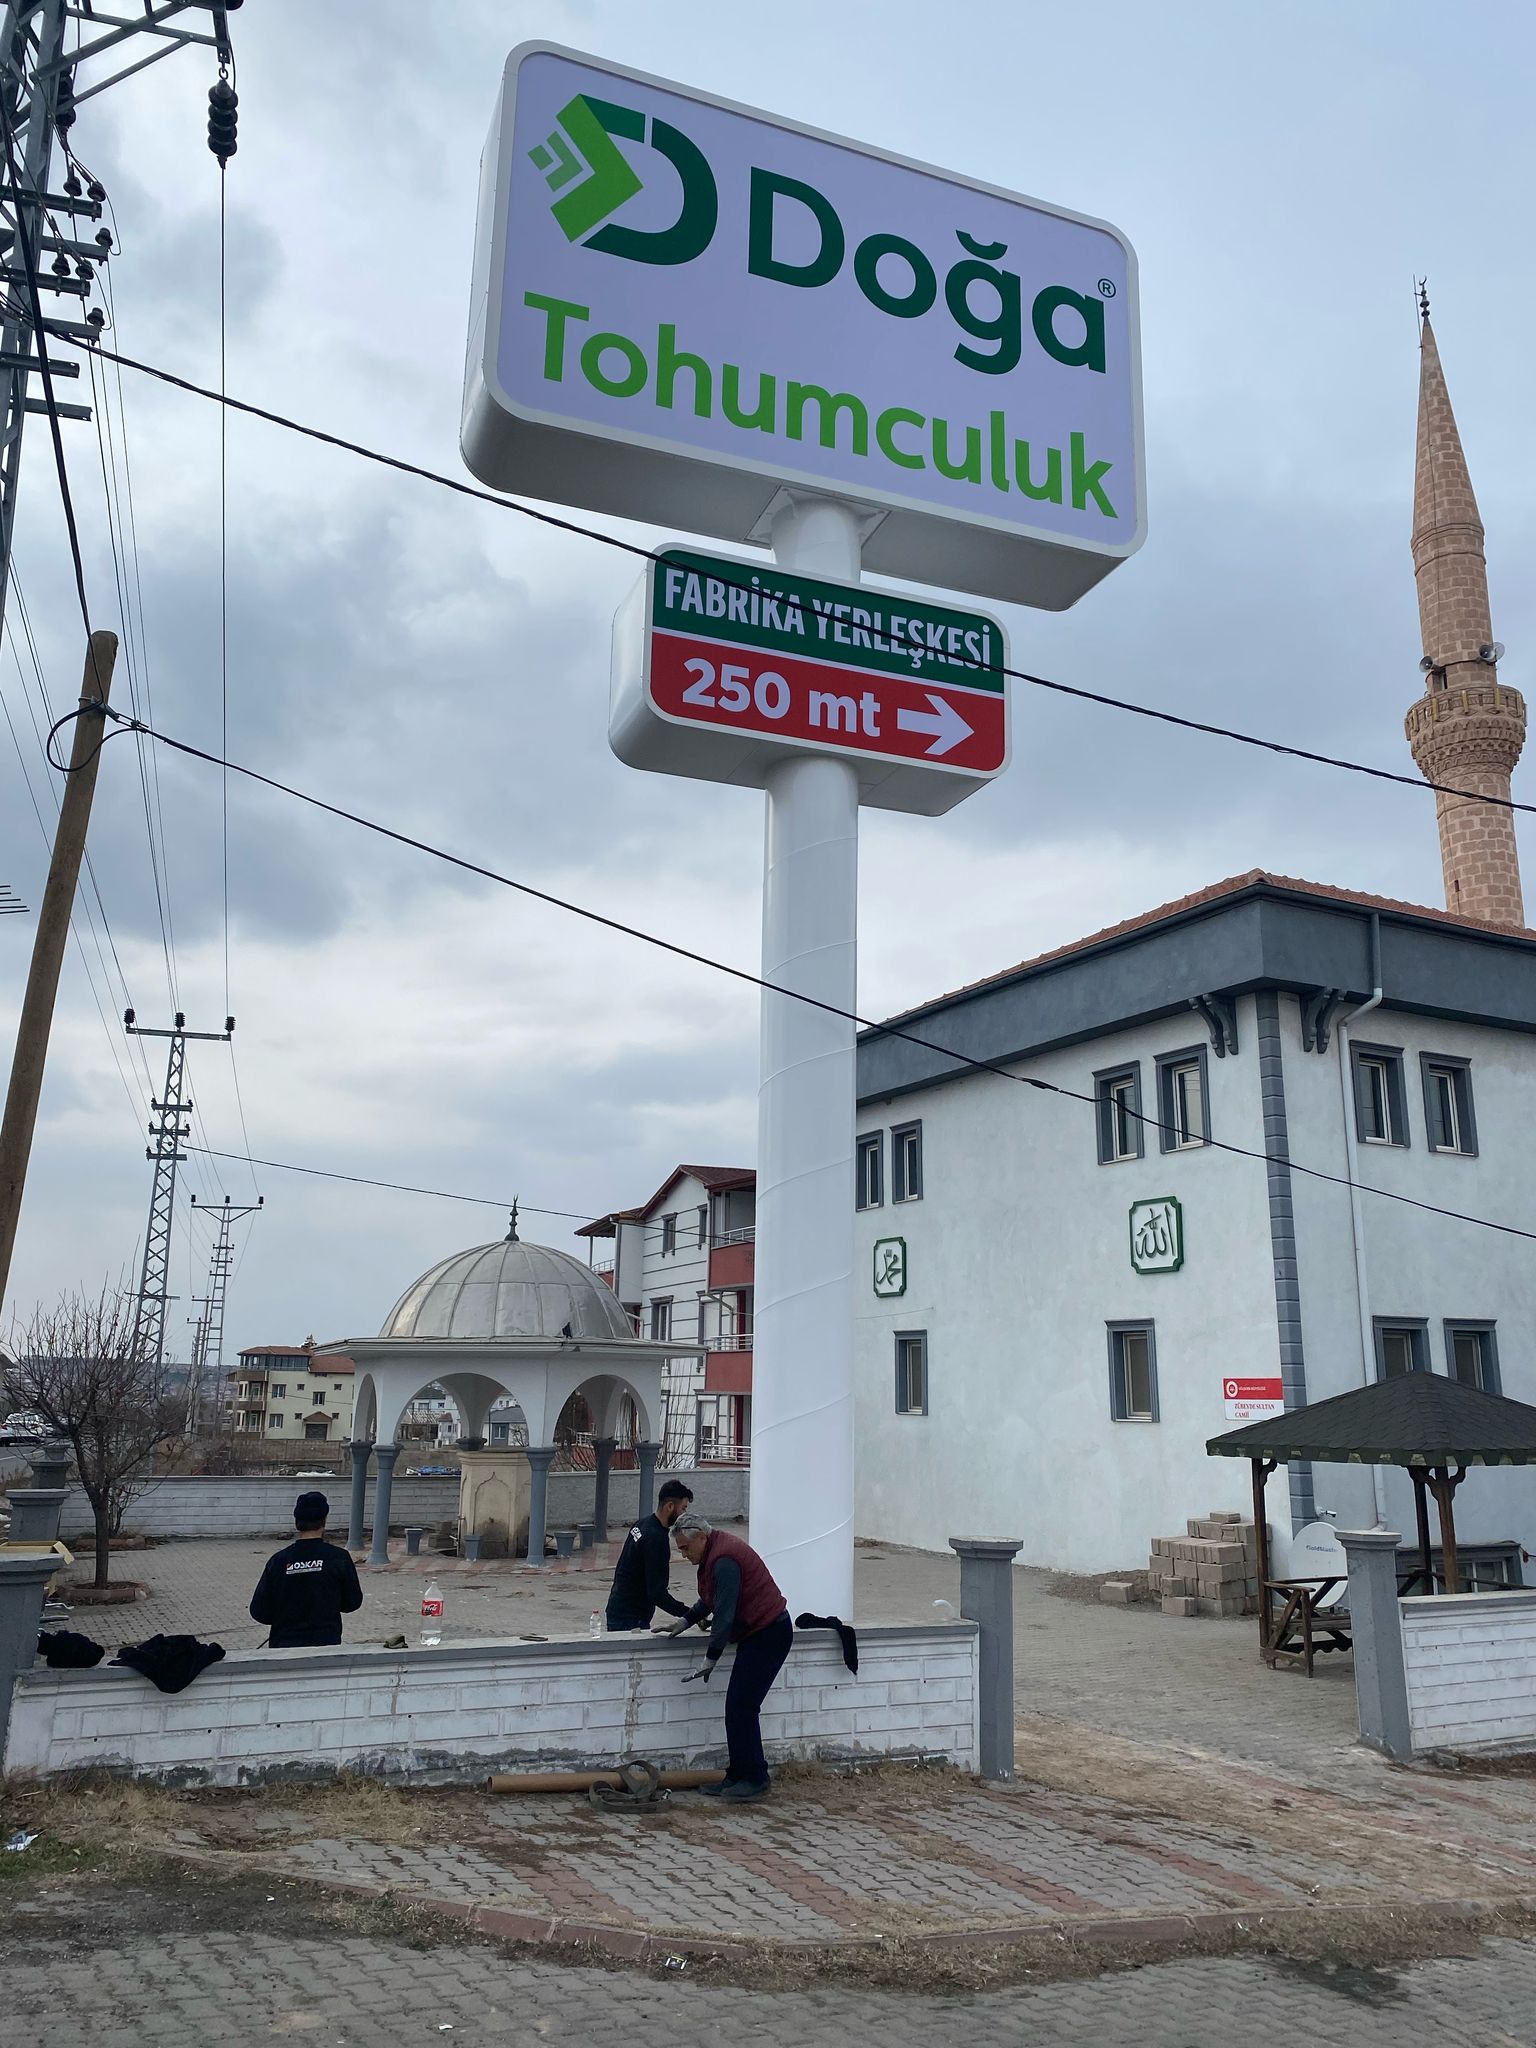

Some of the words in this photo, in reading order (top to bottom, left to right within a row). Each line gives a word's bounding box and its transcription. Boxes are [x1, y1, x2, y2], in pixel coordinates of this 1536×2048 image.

[748, 166, 1107, 375] Doğa
[523, 290, 1119, 519] Tohumculuk
[664, 567, 806, 636] FABRİKA
[811, 597, 992, 673] YERLEŞKESİ
[681, 657, 791, 720] 250
[808, 688, 882, 738] mt
